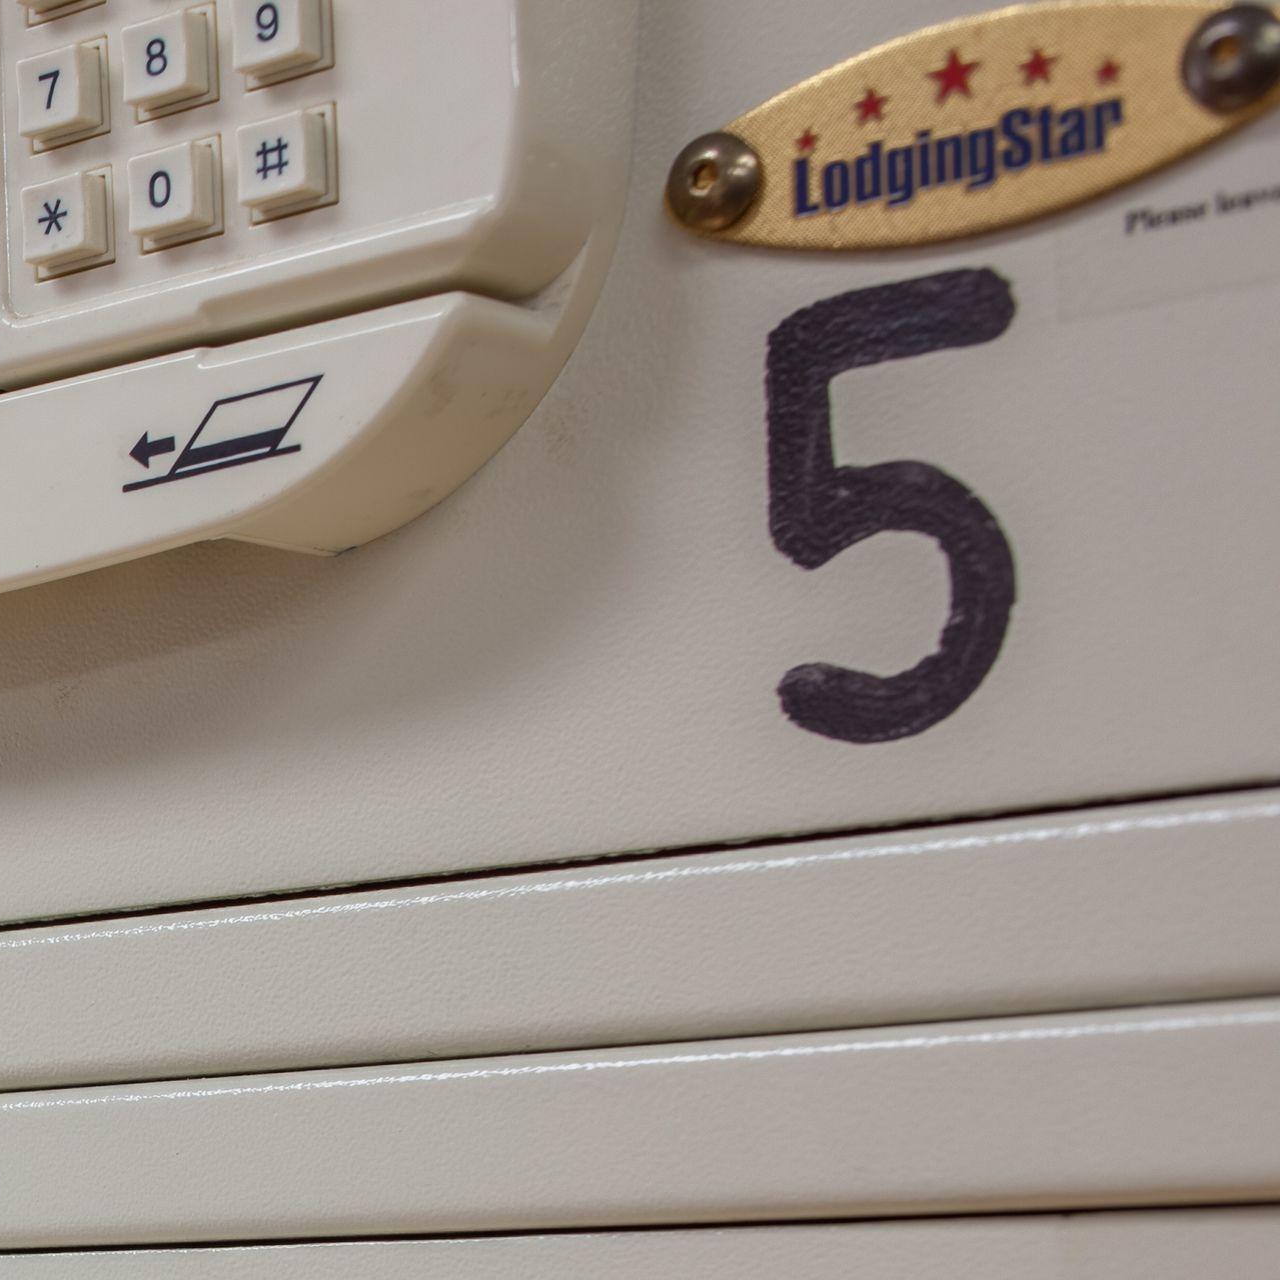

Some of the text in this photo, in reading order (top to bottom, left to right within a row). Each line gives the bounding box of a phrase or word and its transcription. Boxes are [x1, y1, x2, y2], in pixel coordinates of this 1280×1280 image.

[255, 3, 280, 42] 9
[37, 37, 169, 110] 7 8
[148, 136, 289, 209] 0 #
[791, 98, 1124, 218] LodgingStar
[1124, 204, 1206, 235] Please
[765, 267, 1017, 744] 5
